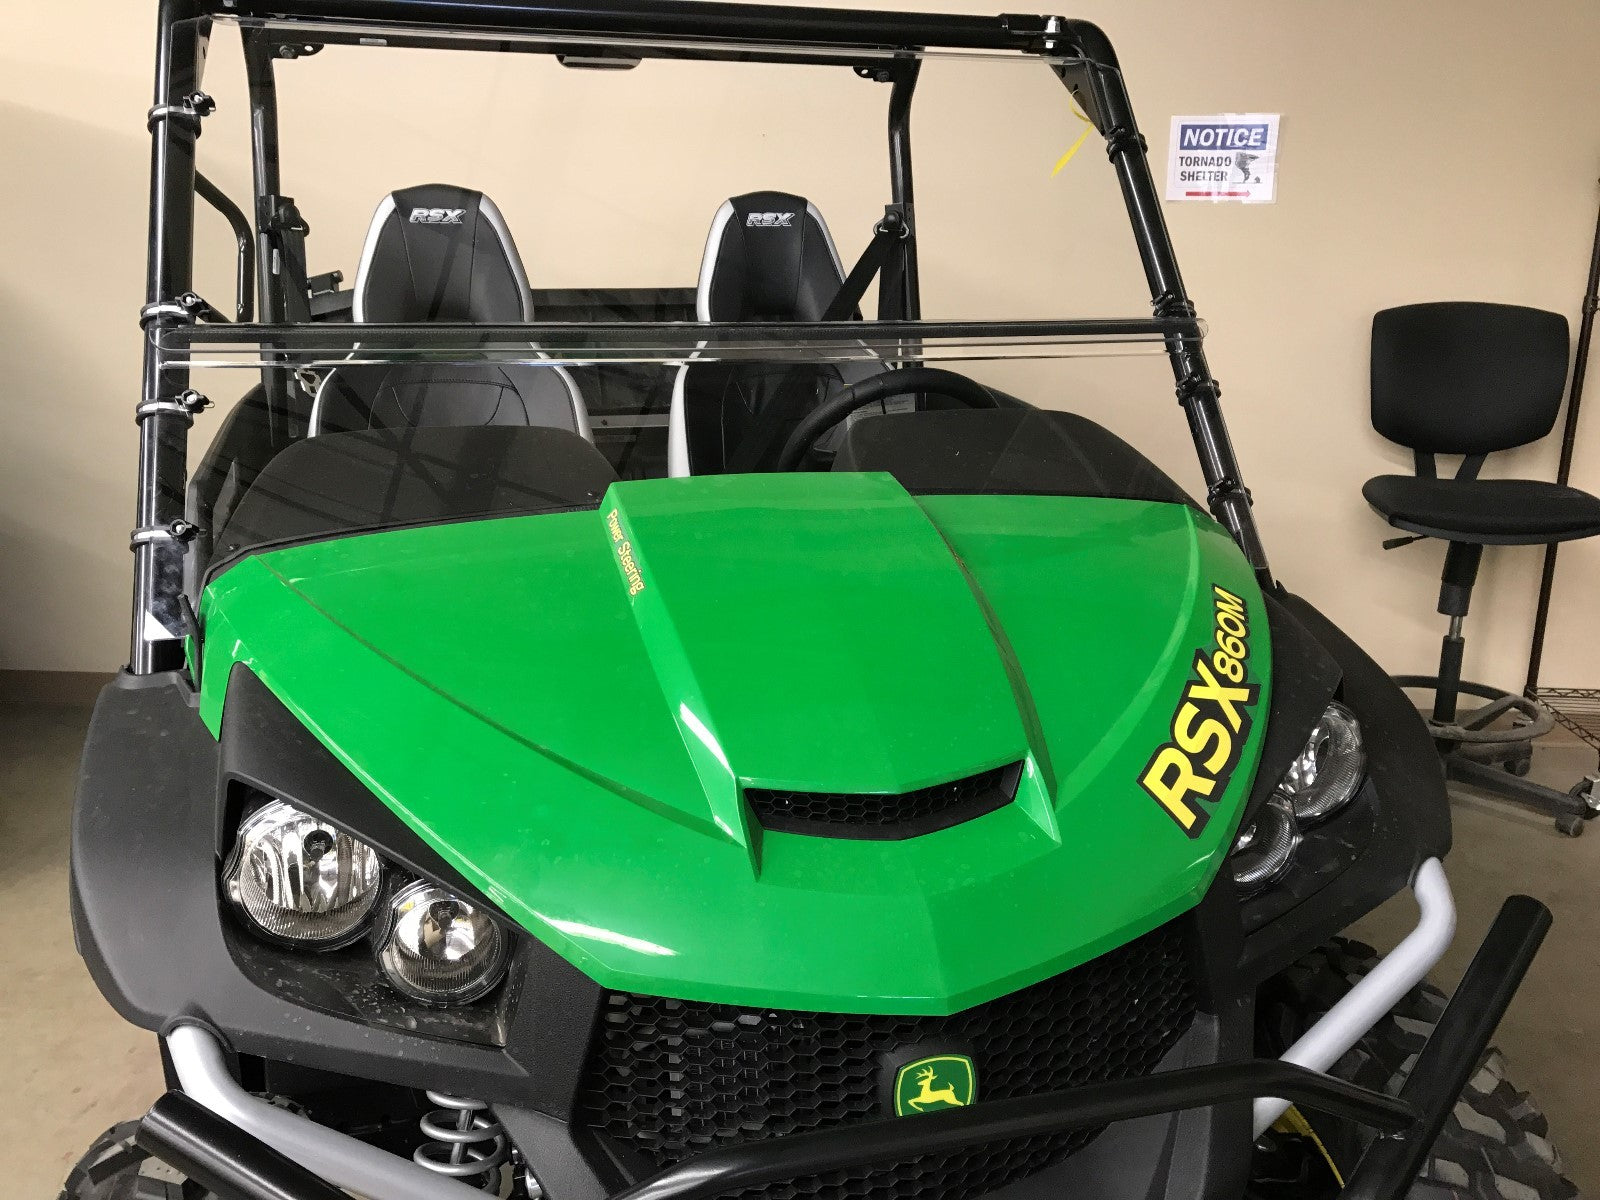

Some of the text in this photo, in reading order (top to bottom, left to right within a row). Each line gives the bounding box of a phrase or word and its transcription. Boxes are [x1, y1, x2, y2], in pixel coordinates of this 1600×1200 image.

[1183, 128, 1264, 147] NOTICE
[1179, 156, 1232, 167] TORNADO
[1180, 170, 1228, 182] SHELTER
[409, 207, 467, 224] RSX
[746, 212, 796, 226] RSX
[606, 508, 645, 596] Power Steering
[1142, 586, 1251, 831] RSX 860M
